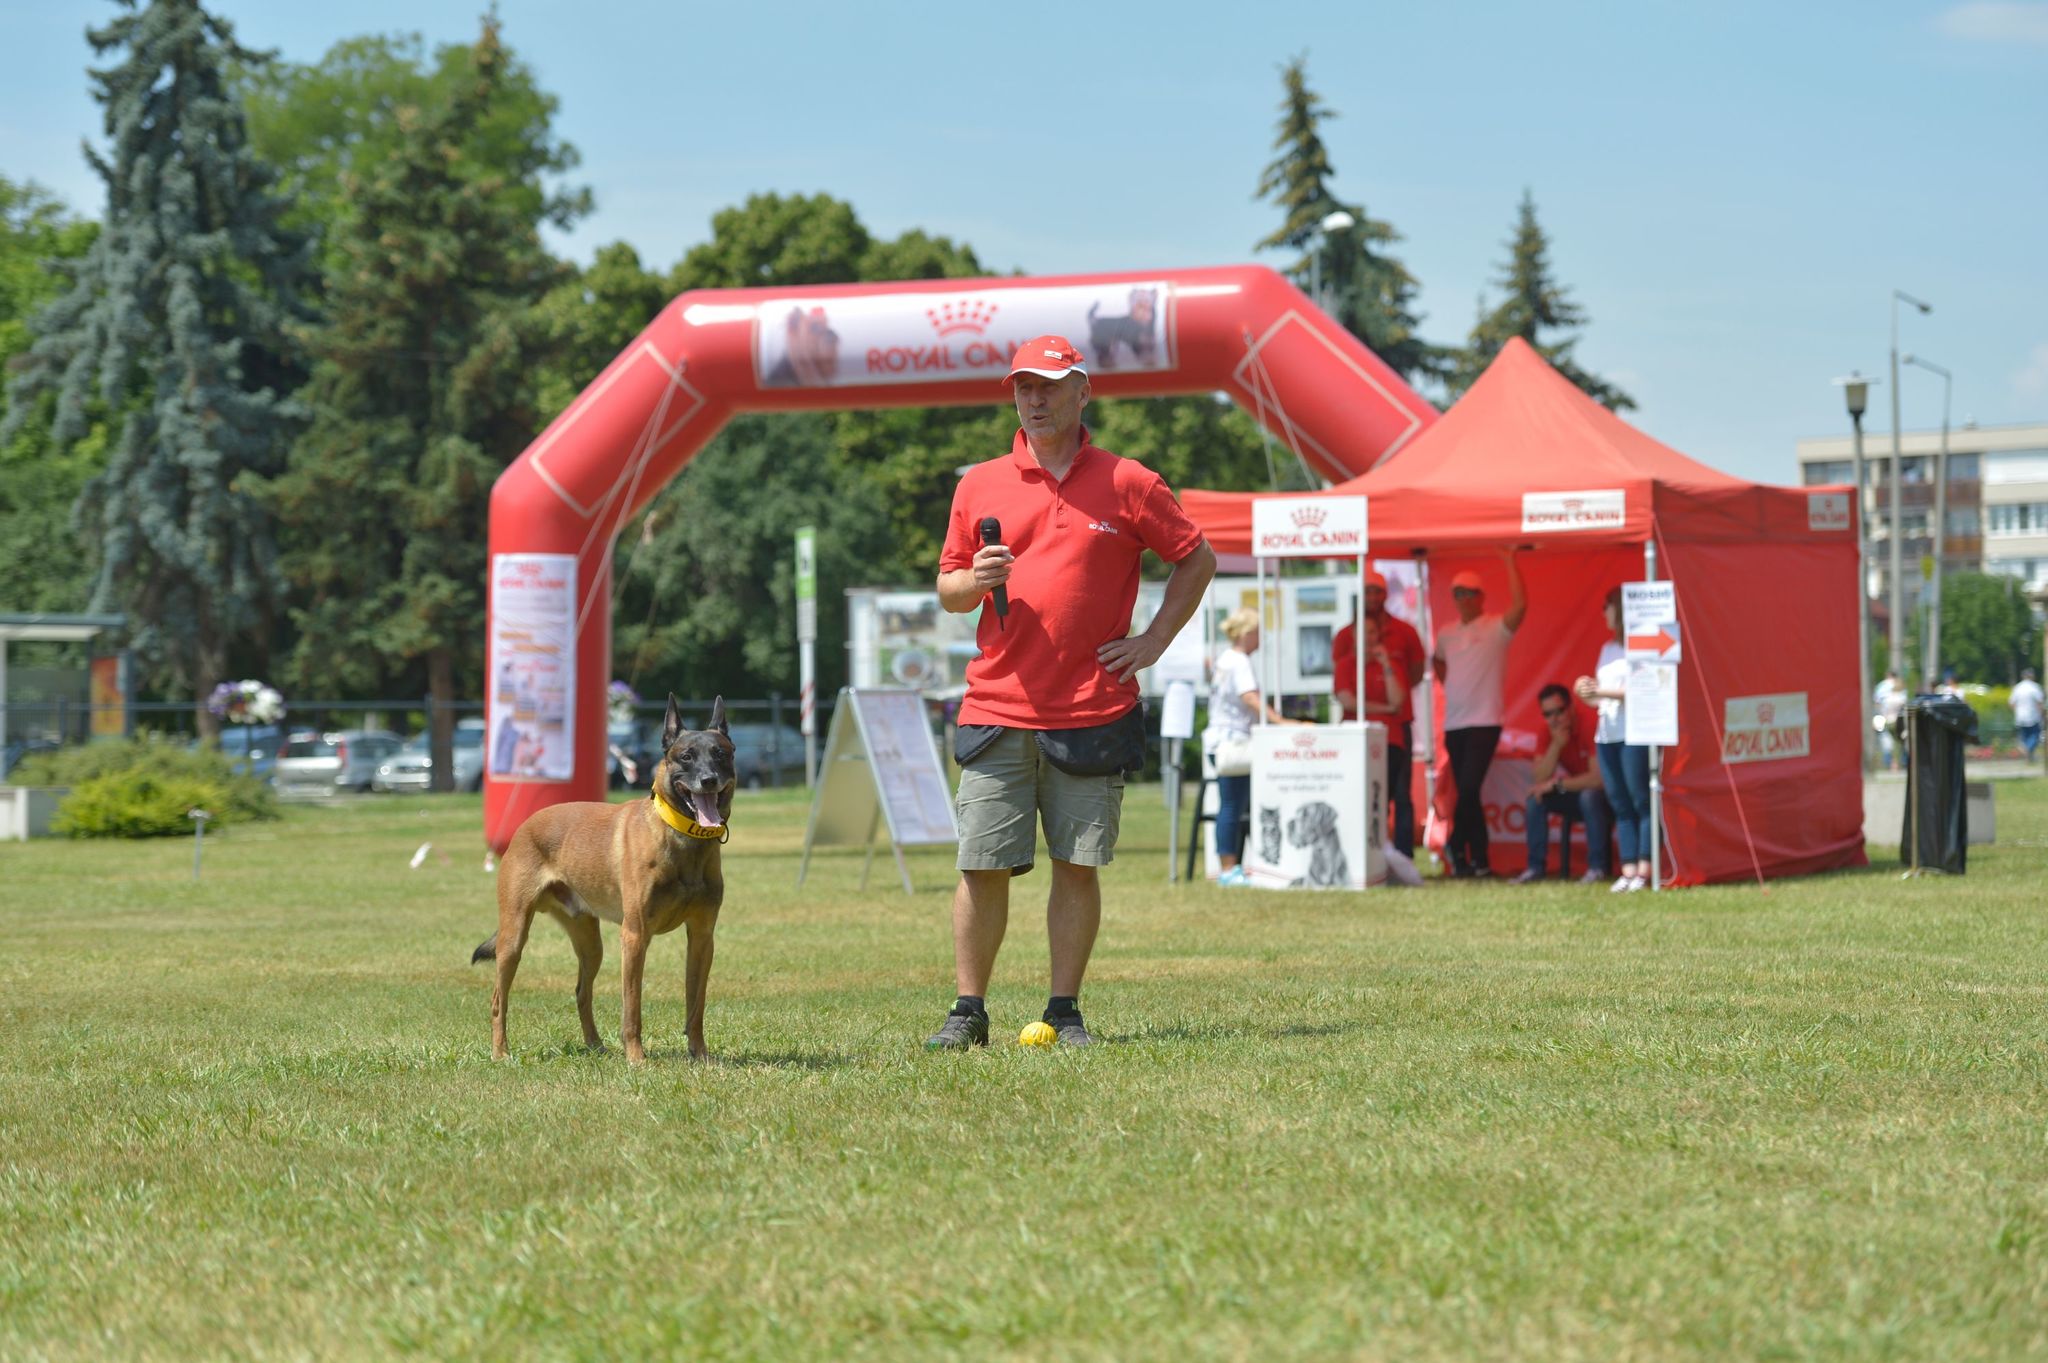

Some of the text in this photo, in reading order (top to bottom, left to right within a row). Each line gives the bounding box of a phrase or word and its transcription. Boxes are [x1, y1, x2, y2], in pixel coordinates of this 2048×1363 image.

[867, 339, 1025, 374] ROYAL CAN
[1262, 531, 1359, 548] ROYAL CANIN
[1726, 727, 1802, 756] ROYAL CANIN
